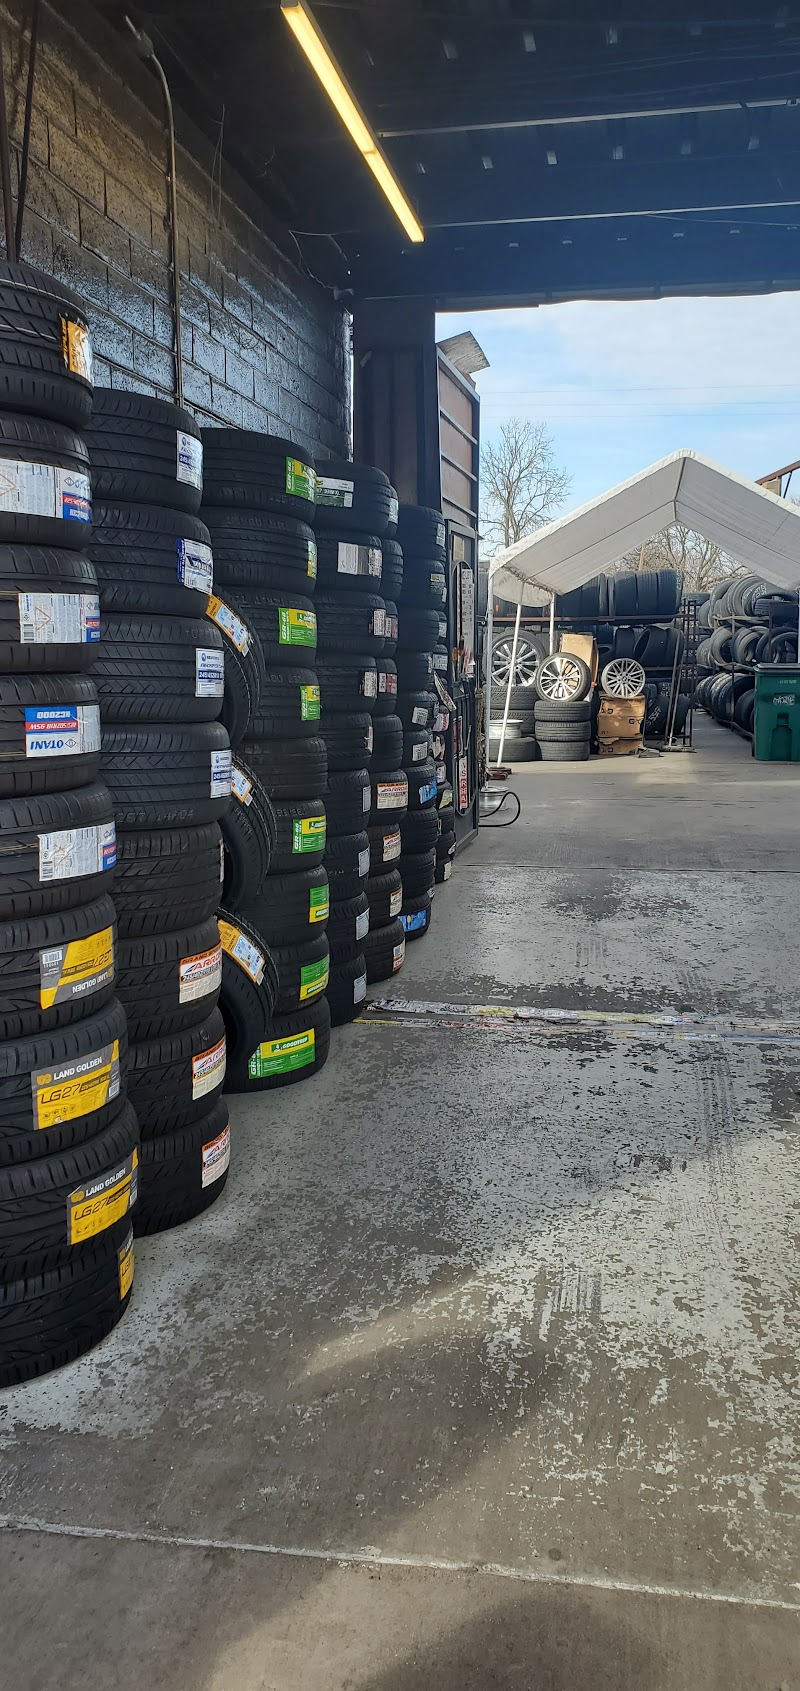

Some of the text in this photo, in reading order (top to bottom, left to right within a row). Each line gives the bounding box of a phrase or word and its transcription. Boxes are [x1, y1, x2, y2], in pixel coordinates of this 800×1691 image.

[30, 740, 64, 750] OTANI
[182, 952, 207, 964] GRAND
[72, 972, 108, 993] LAND GOLDEN
[282, 1037, 308, 1049] GOODTRIP
[54, 1056, 102, 1080] LAND GOLDEN
[41, 1083, 80, 1104] LG27
[86, 1168, 126, 1197] LAND GOLDEN
[74, 1198, 108, 1221] LG27
